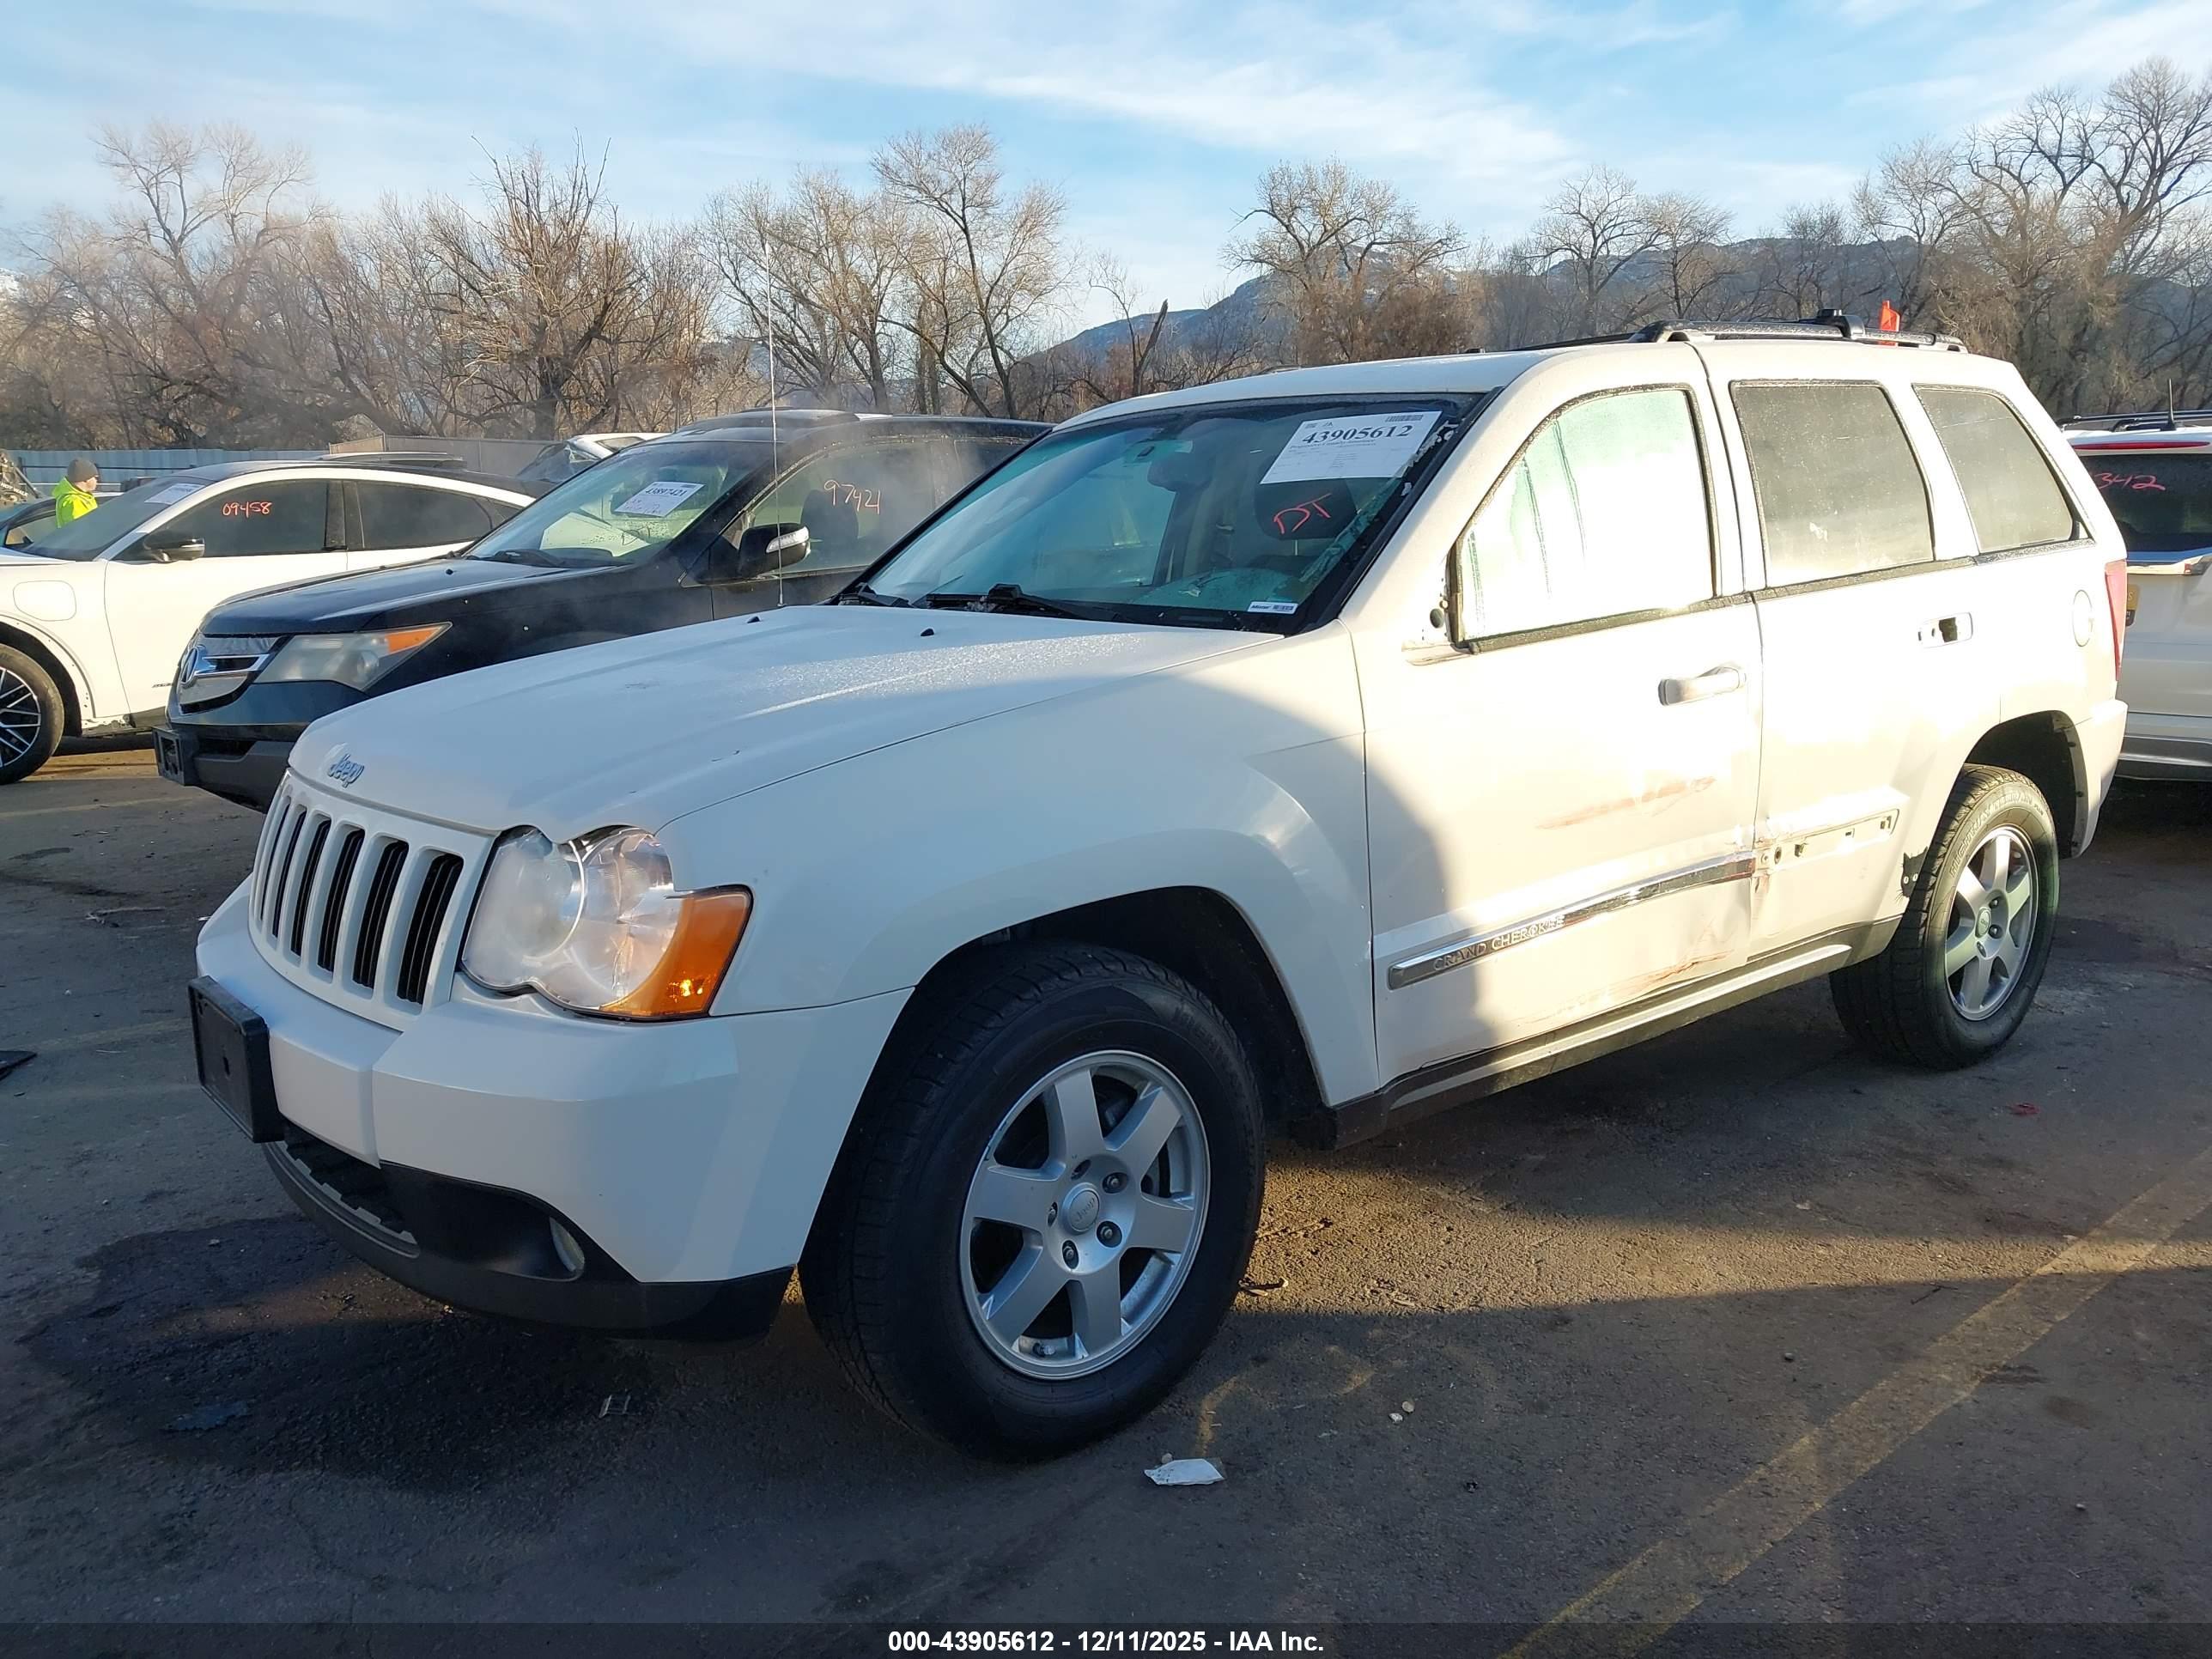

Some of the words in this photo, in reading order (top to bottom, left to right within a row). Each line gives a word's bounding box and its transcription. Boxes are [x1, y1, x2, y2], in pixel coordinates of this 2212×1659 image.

[1303, 424, 1413, 444] 43905612
[222, 501, 273, 518] 09458
[823, 479, 881, 515] 97421
[327, 753, 365, 788] Jeep
[1432, 943, 1486, 971] GRAND
[1491, 914, 1565, 951] CHEROKEE
